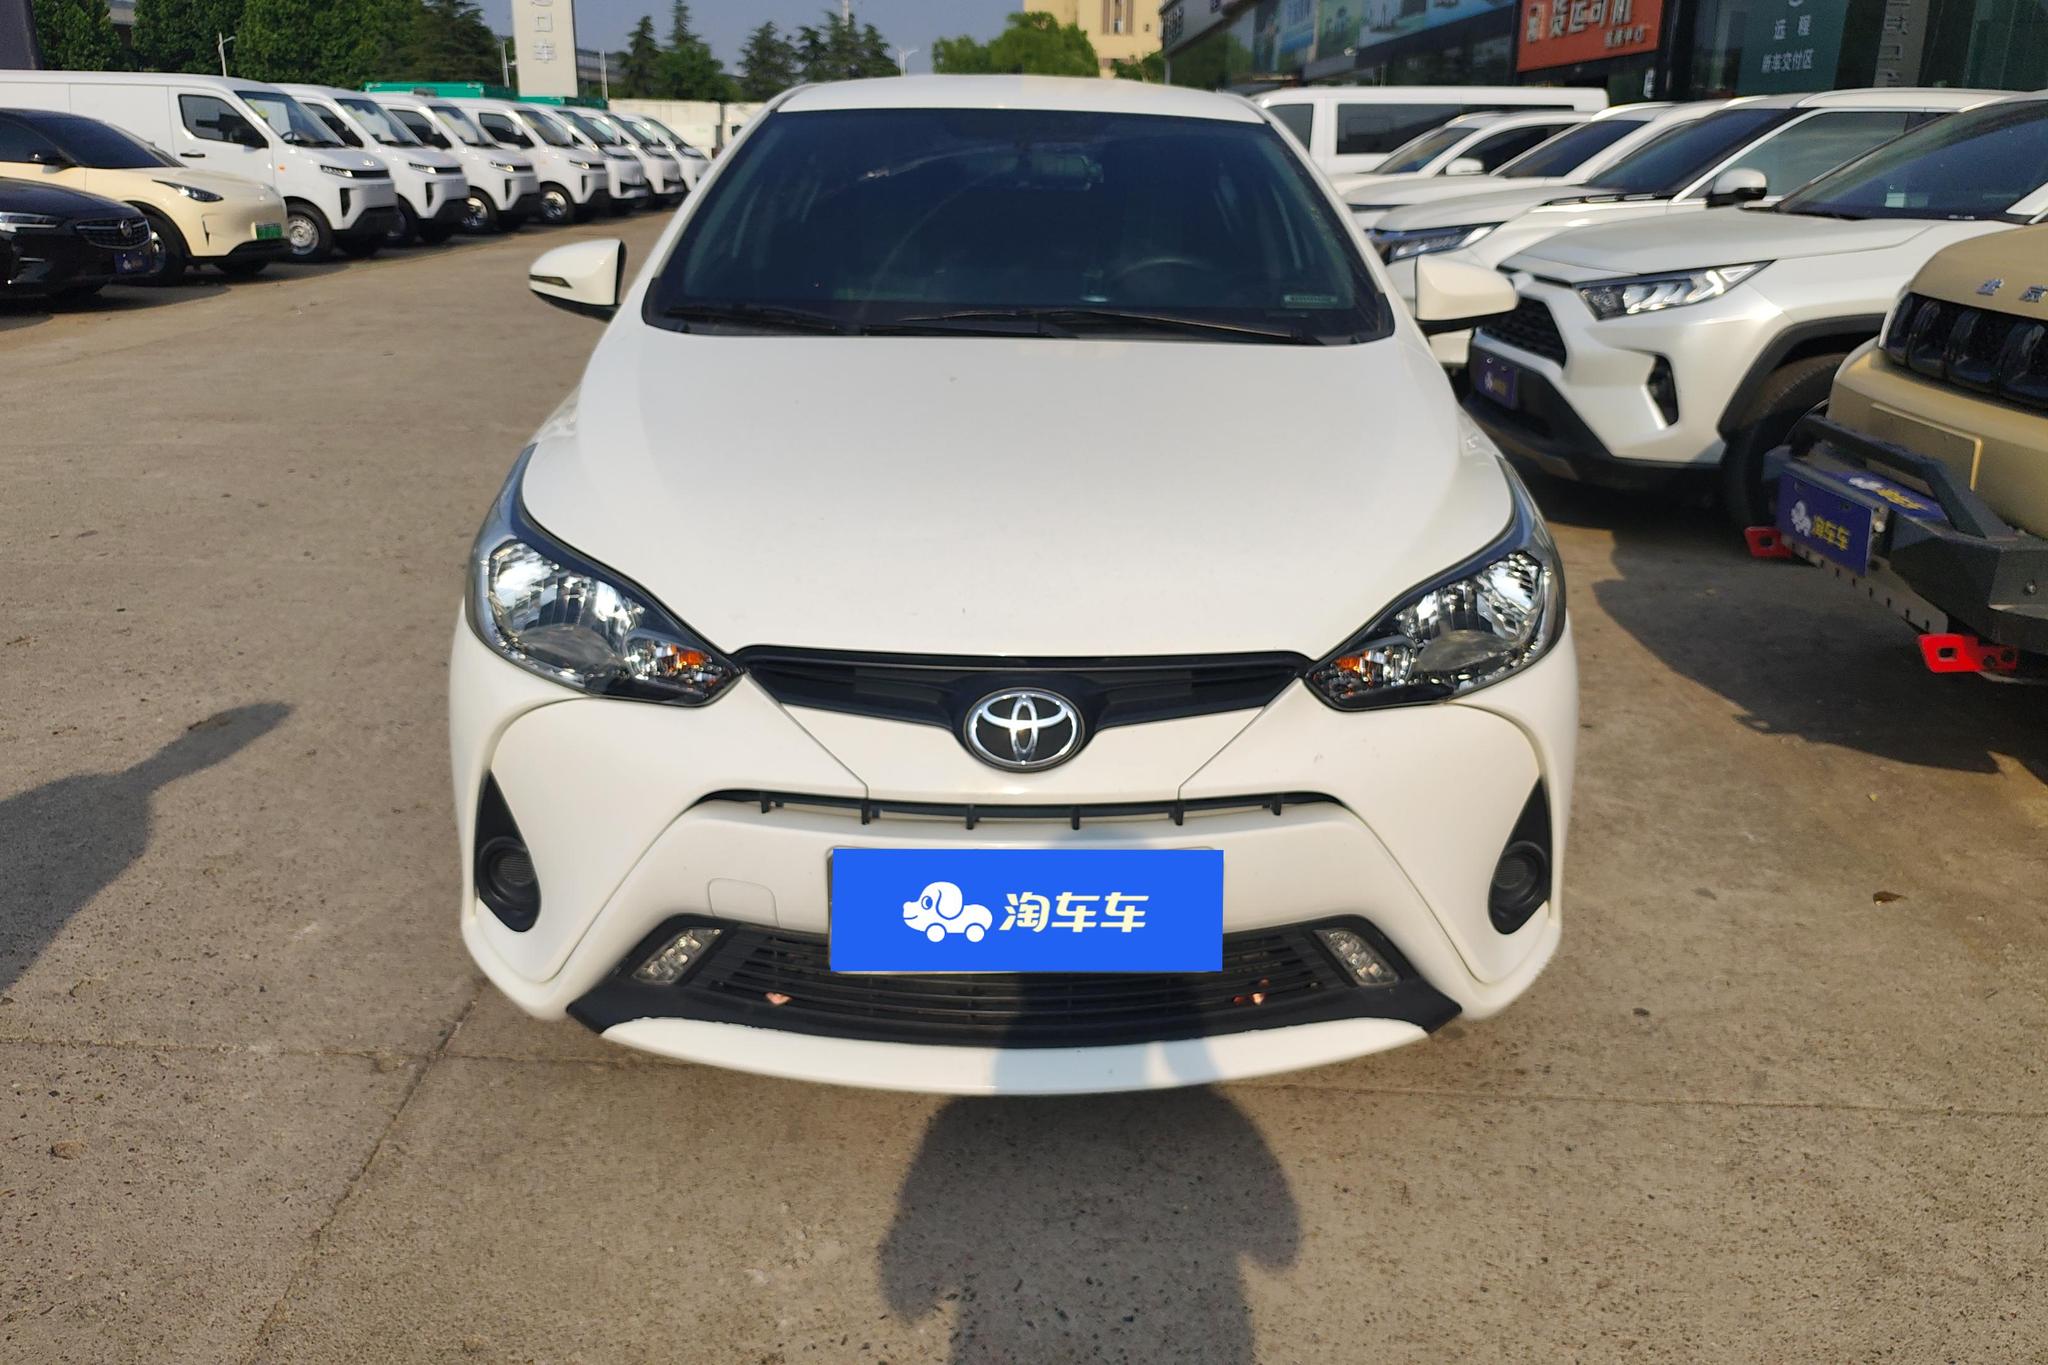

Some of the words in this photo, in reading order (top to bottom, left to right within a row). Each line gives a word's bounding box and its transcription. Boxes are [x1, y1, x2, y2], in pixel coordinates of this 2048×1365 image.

[1761, 49, 1814, 74] 新车交付区
